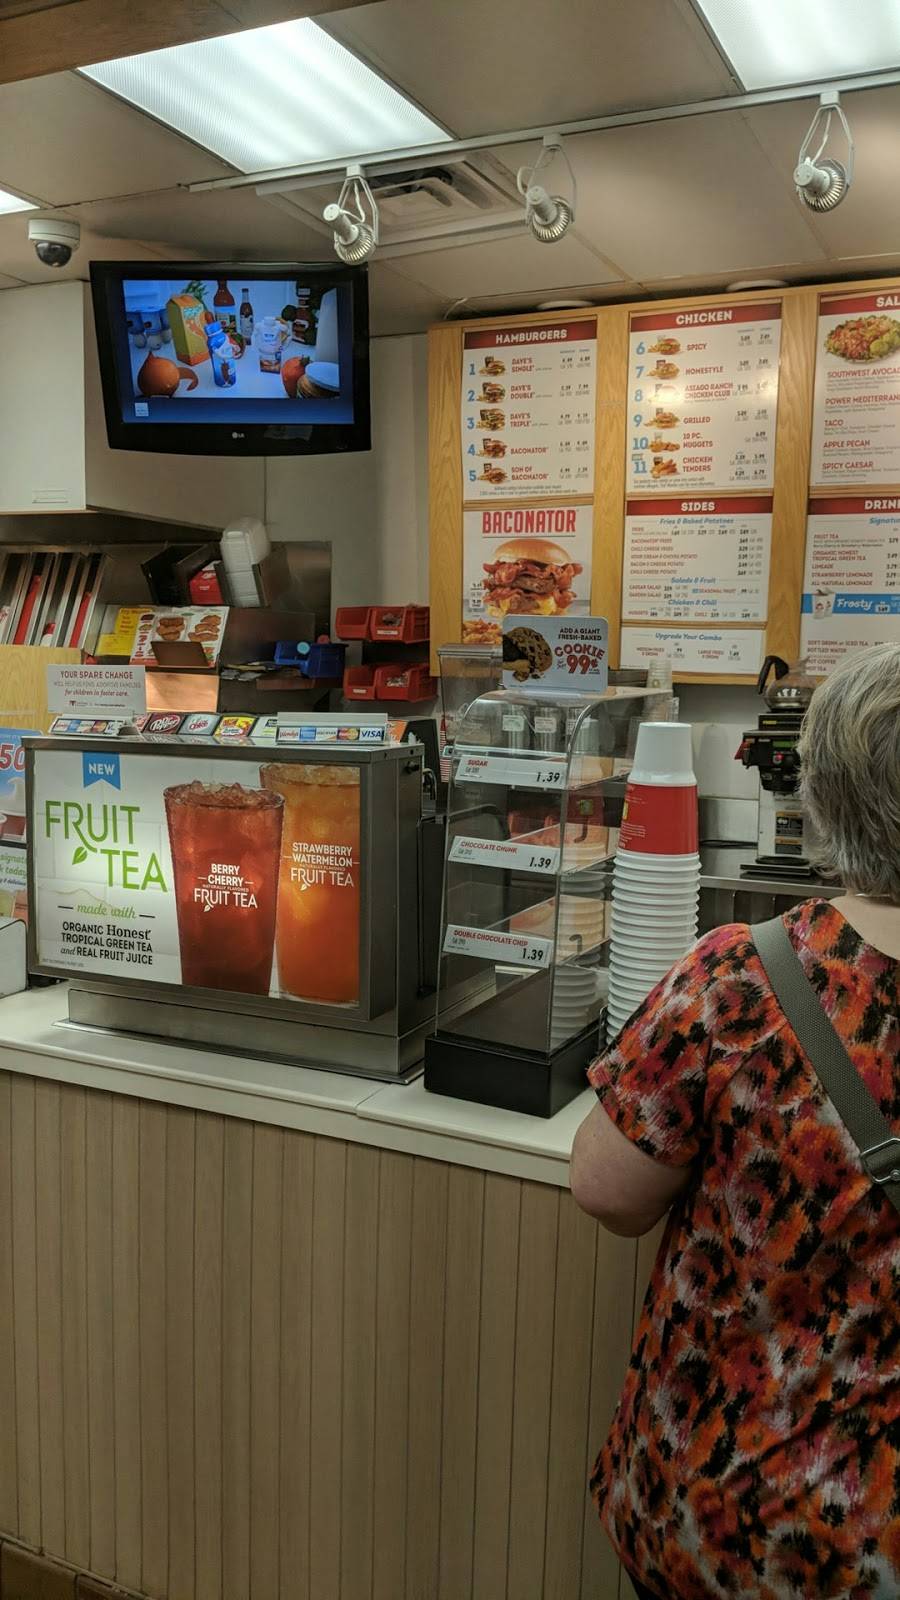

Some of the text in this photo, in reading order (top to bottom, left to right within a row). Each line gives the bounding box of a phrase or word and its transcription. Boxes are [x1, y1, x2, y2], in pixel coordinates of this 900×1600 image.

[675, 310, 733, 326] CHICKEN
[495, 329, 568, 344] HAMBURGERS
[636, 342, 707, 355] 6 SPICY
[469, 364, 476, 376] 1
[635, 366, 723, 379] 7 HOMESTYLE
[827, 369, 870, 379] SOUTHWEST
[710, 382, 733, 390] RANCH
[467, 391, 475, 402] 2
[634, 389, 730, 402] 8 CHICKEN CLUB
[825, 397, 850, 405] POWER
[467, 418, 475, 429] 3
[633, 414, 711, 427] 9 GRILLED
[824, 419, 844, 427] TACO
[632, 437, 649, 450] 10
[467, 445, 475, 456] 4
[633, 462, 711, 474] 11 TENDERS
[822, 461, 874, 470] SPICY CAESAR
[469, 471, 476, 482] 5
[681, 502, 715, 512] SIDES
[482, 510, 577, 533] BACONATOR
[836, 598, 873, 611] Frosty
[555, 643, 605, 660] COOKIE
[79, 671, 102, 679] SPARE
[104, 671, 133, 680] CHANGE
[361, 730, 382, 738] VISA
[88, 763, 115, 776] NEW
[467, 759, 488, 767] SUGAR
[536, 772, 560, 782] 1.39
[45, 800, 140, 853] FRUIT
[292, 842, 353, 856] STRAWBERRY
[460, 841, 518, 853] CHOCOLATE CHUNK
[292, 853, 353, 867] WATERMELON
[529, 857, 552, 868] 1.39
[100, 848, 168, 893] TEA
[211, 863, 240, 875] BERRY
[207, 874, 244, 887] CHERRY
[291, 867, 355, 888] FRUIT TEA
[194, 887, 258, 909] FRUIT TEA
[76, 903, 138, 919] made with
[62, 921, 151, 940] ORGANIC Honest
[61, 932, 153, 953] TROPICAL GREEN TEA
[453, 929, 529, 947] DOUBLE CHOCOLATE CHIP
[60, 946, 153, 966] and REAL FRUIT JUICE
[522, 948, 544, 961] 1.39
